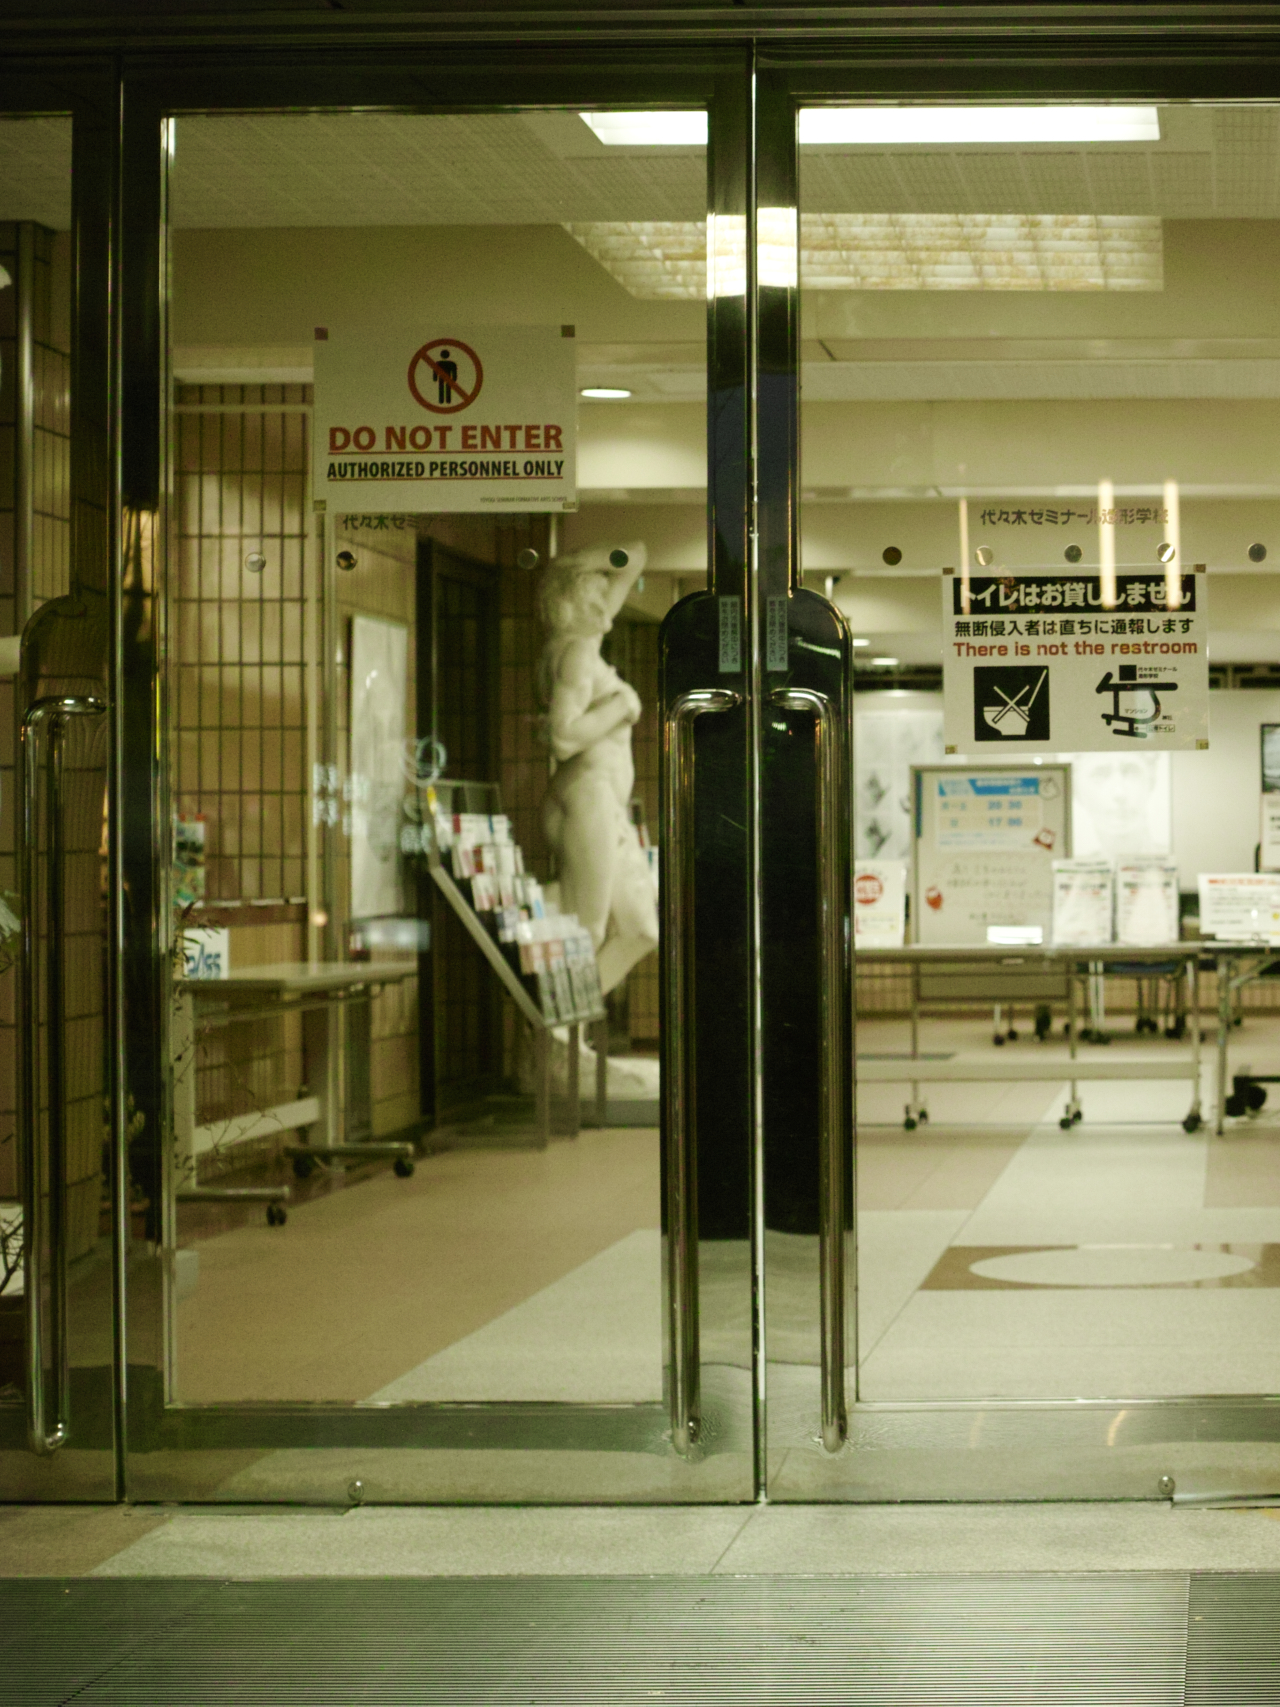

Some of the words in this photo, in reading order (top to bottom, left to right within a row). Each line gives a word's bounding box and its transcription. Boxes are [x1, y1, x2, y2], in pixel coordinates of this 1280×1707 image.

[328, 426, 377, 452] DO
[385, 425, 453, 451] NOT
[461, 424, 563, 450] ENTER
[327, 461, 425, 478] AUTHORIZED
[429, 460, 520, 477] PERSONNEL
[523, 460, 564, 476] ONLY
[980, 508, 1169, 526] 代々木ゼミナール造形学校
[954, 618, 1195, 638] 無断侵入者は直ちに通報します
[953, 642, 1008, 657] There
[1014, 641, 1031, 656] is
[1037, 642, 1069, 656] not
[1073, 641, 1105, 656] the
[1110, 640, 1198, 655] restroom
